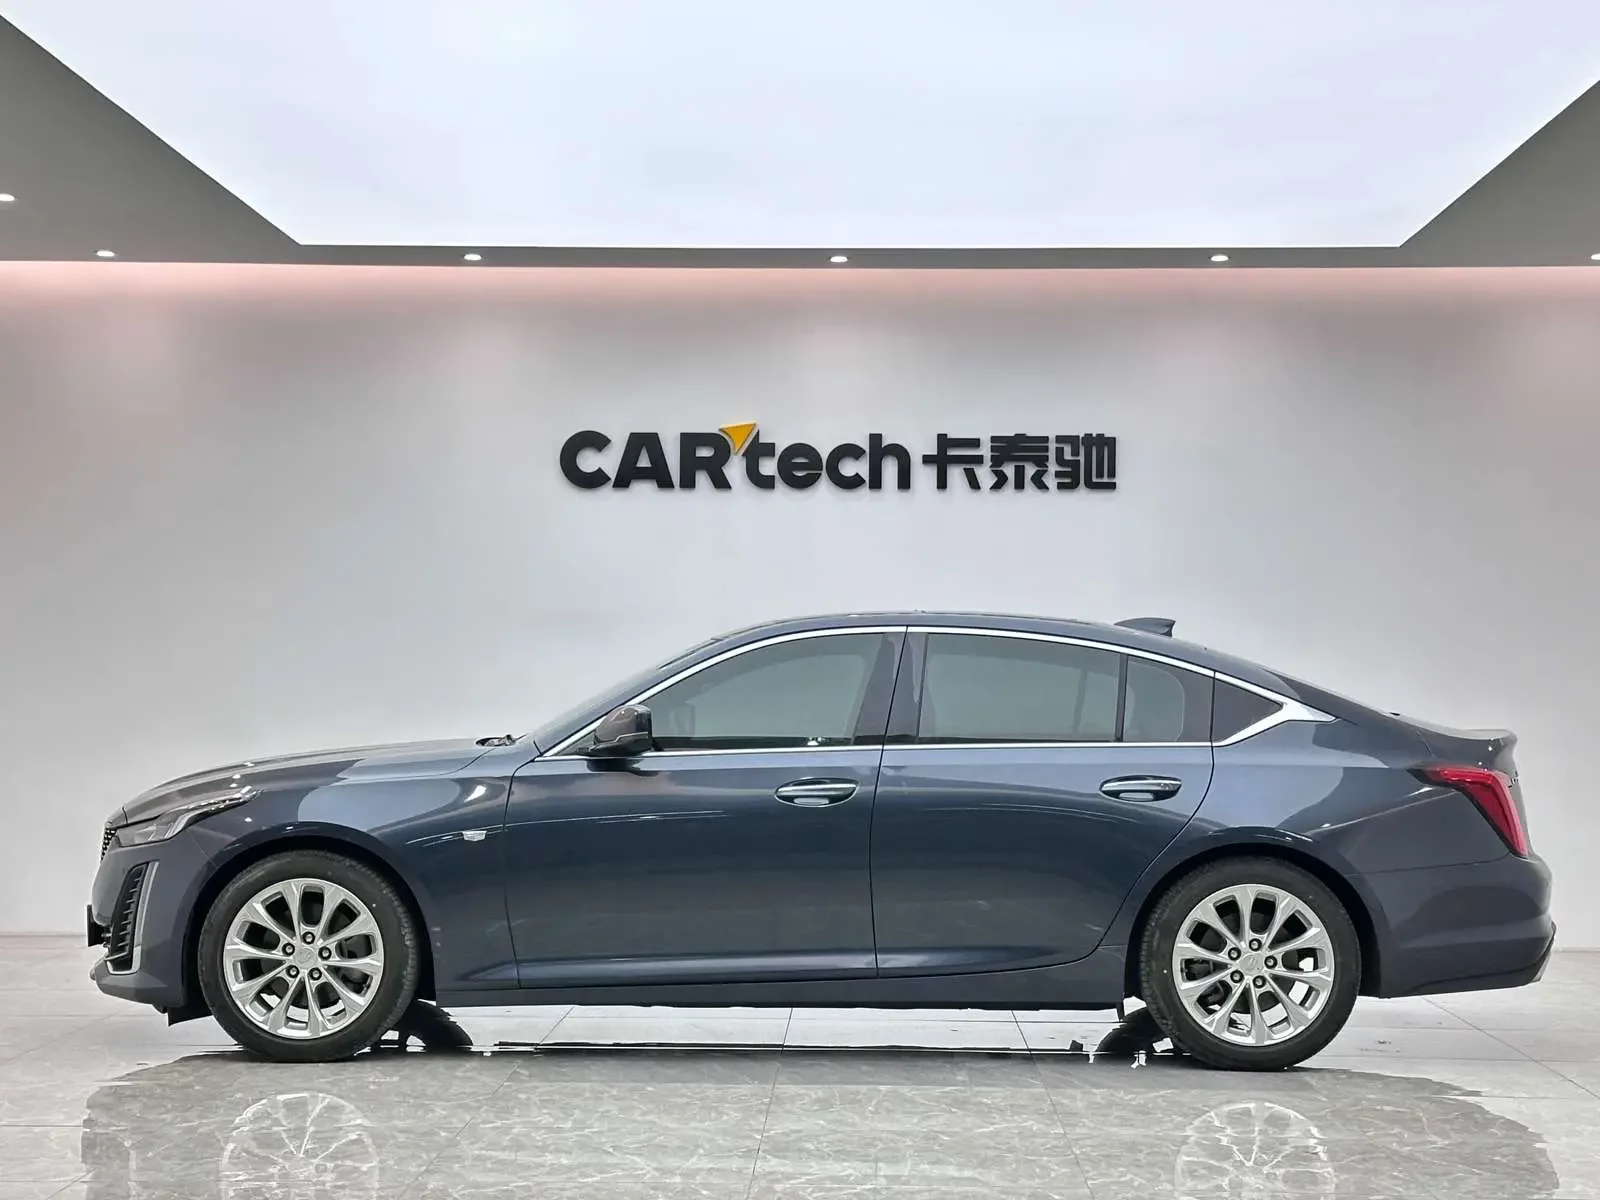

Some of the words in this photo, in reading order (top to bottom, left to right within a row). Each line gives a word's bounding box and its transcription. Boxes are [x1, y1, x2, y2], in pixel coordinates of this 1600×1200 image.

[559, 429, 912, 490] CARtech
[922, 432, 1117, 490] 卡泰驰
